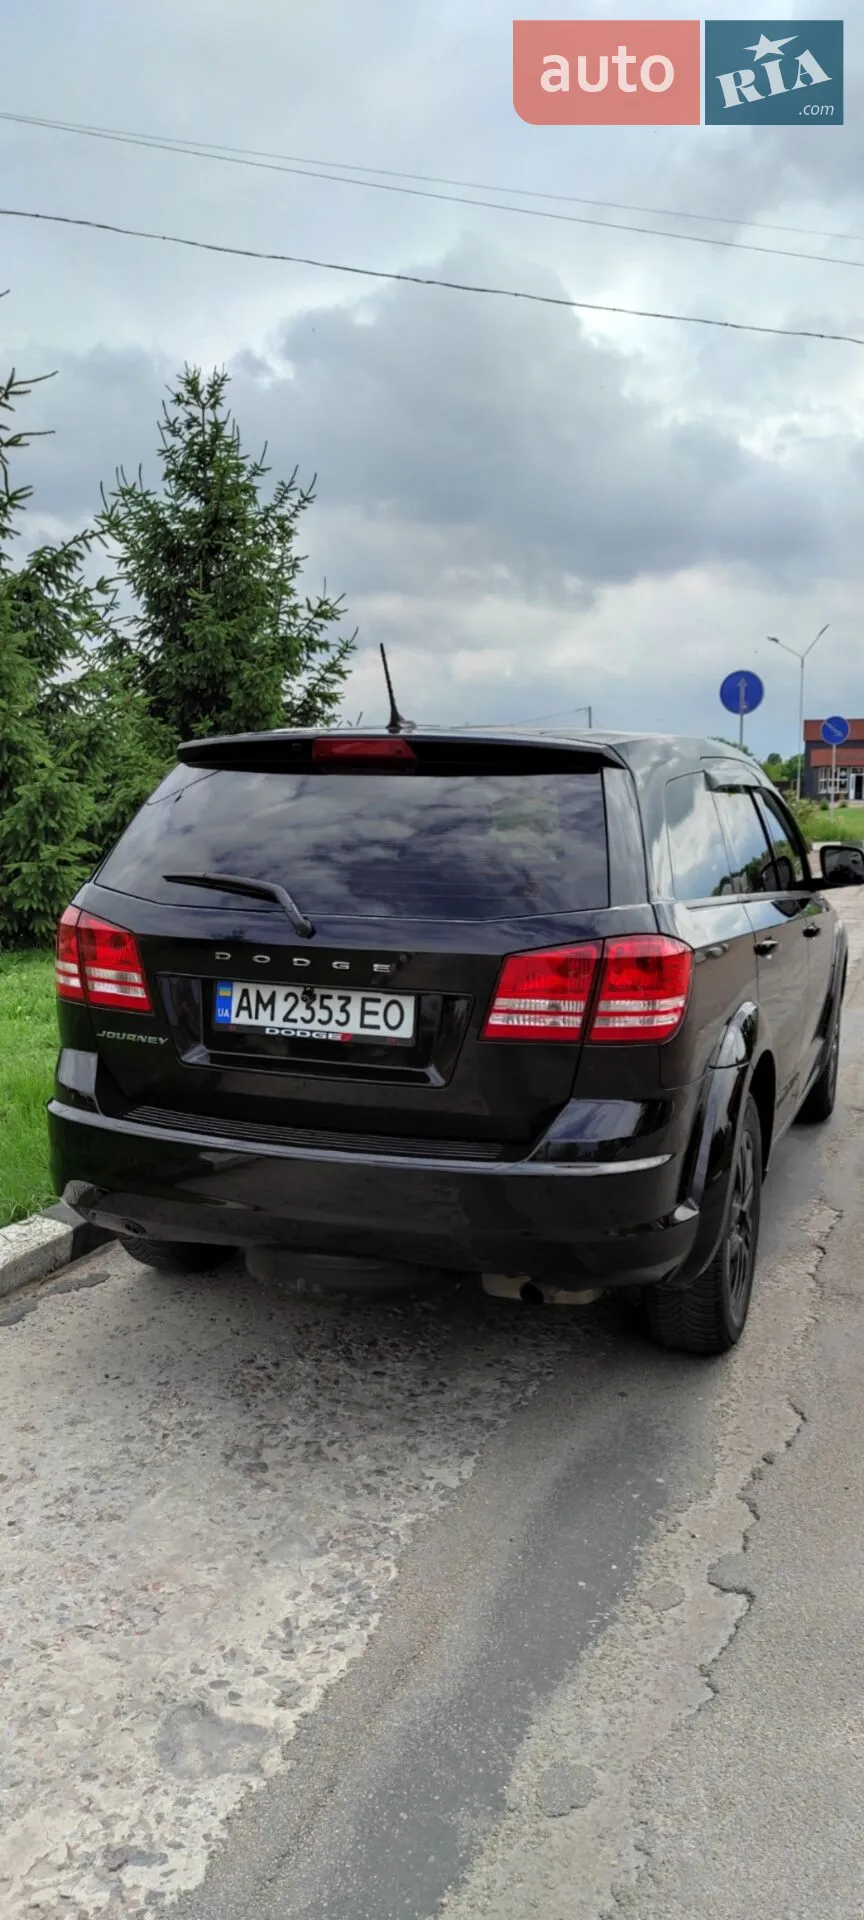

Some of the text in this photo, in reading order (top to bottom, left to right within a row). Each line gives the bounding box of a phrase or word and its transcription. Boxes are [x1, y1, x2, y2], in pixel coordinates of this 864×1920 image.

[215, 951, 391, 973] DODGE
[217, 1008, 230, 1018] UA
[235, 988, 405, 1031] AM 2353 EO
[95, 1029, 170, 1045] JOURNEY
[265, 1027, 342, 1041] DODGE
